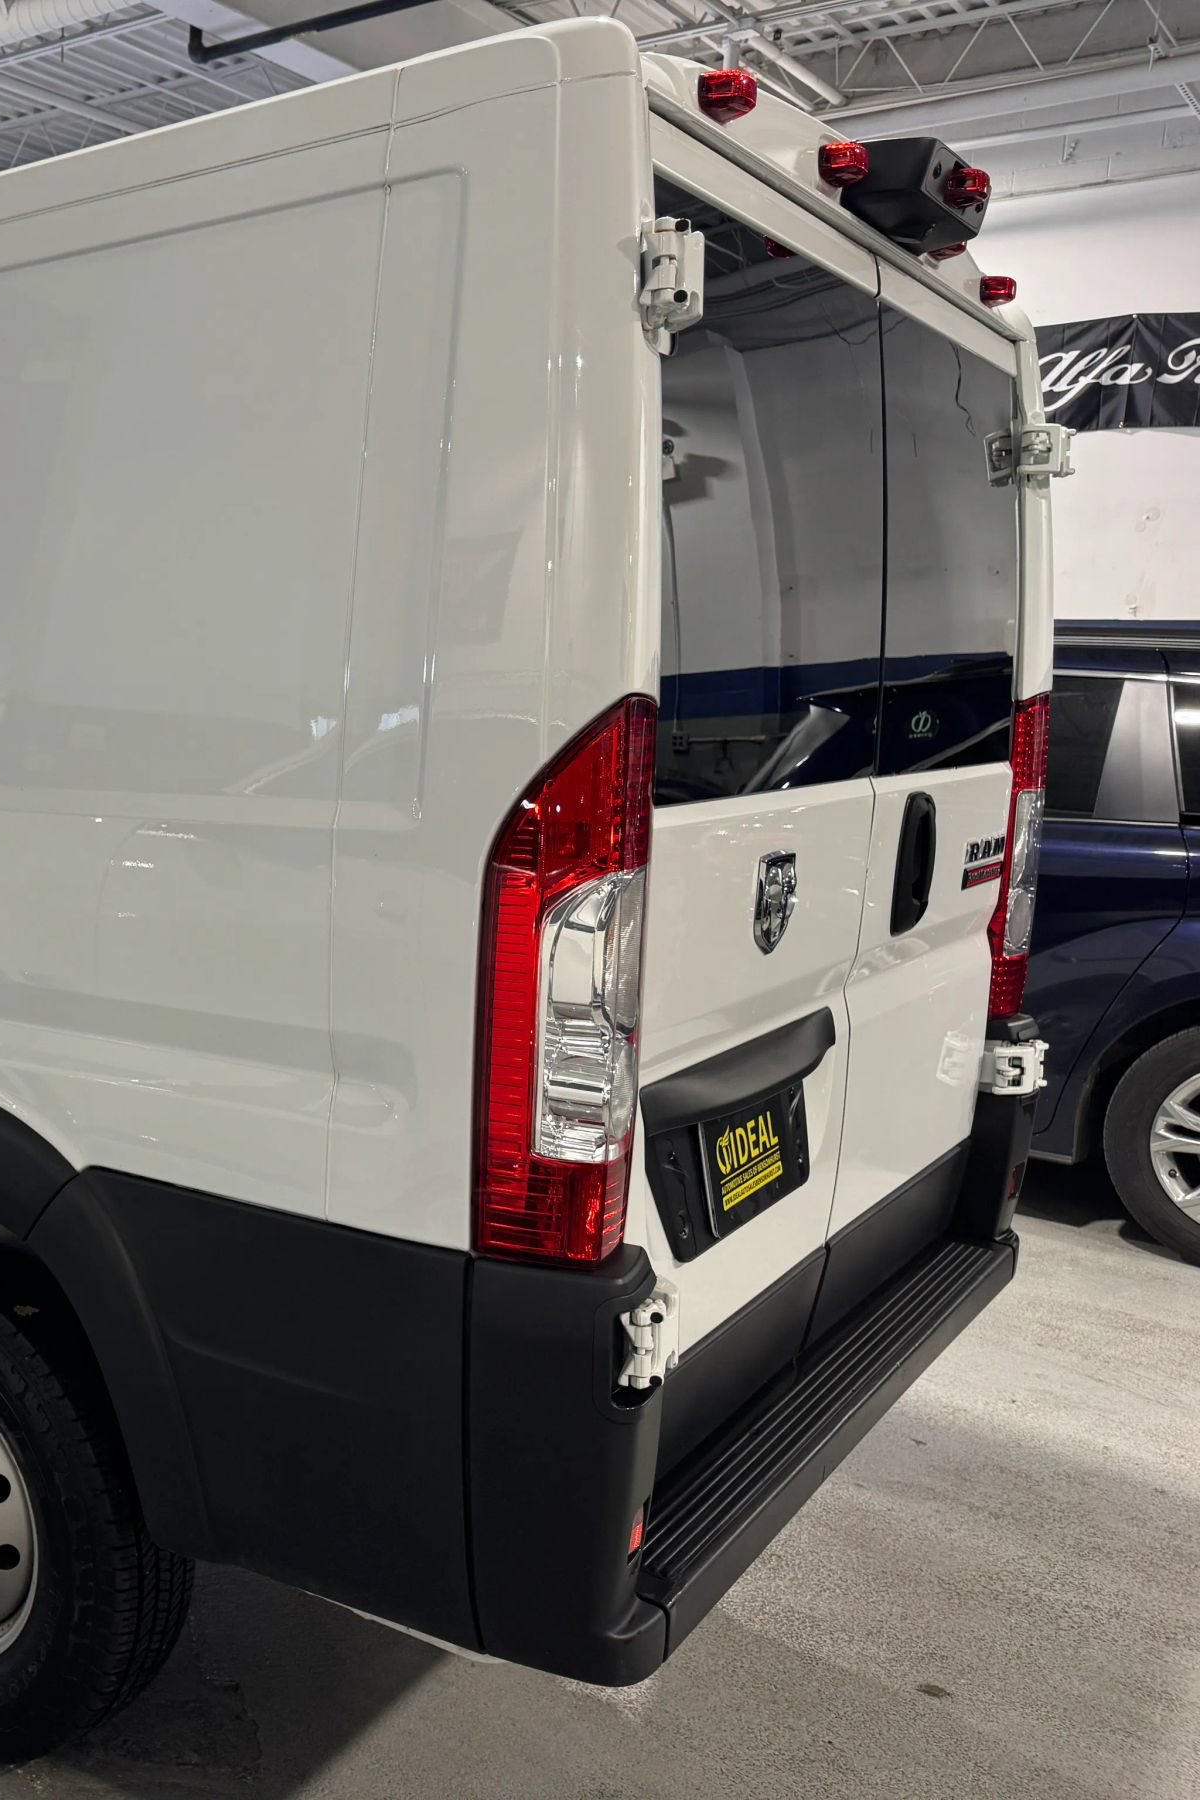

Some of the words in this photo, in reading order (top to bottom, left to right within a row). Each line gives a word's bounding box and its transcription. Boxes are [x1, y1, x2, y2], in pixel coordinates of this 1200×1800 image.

[1038, 344, 1152, 412] Alfa
[964, 834, 1006, 864] RAM
[729, 1110, 779, 1169] IDEAL
